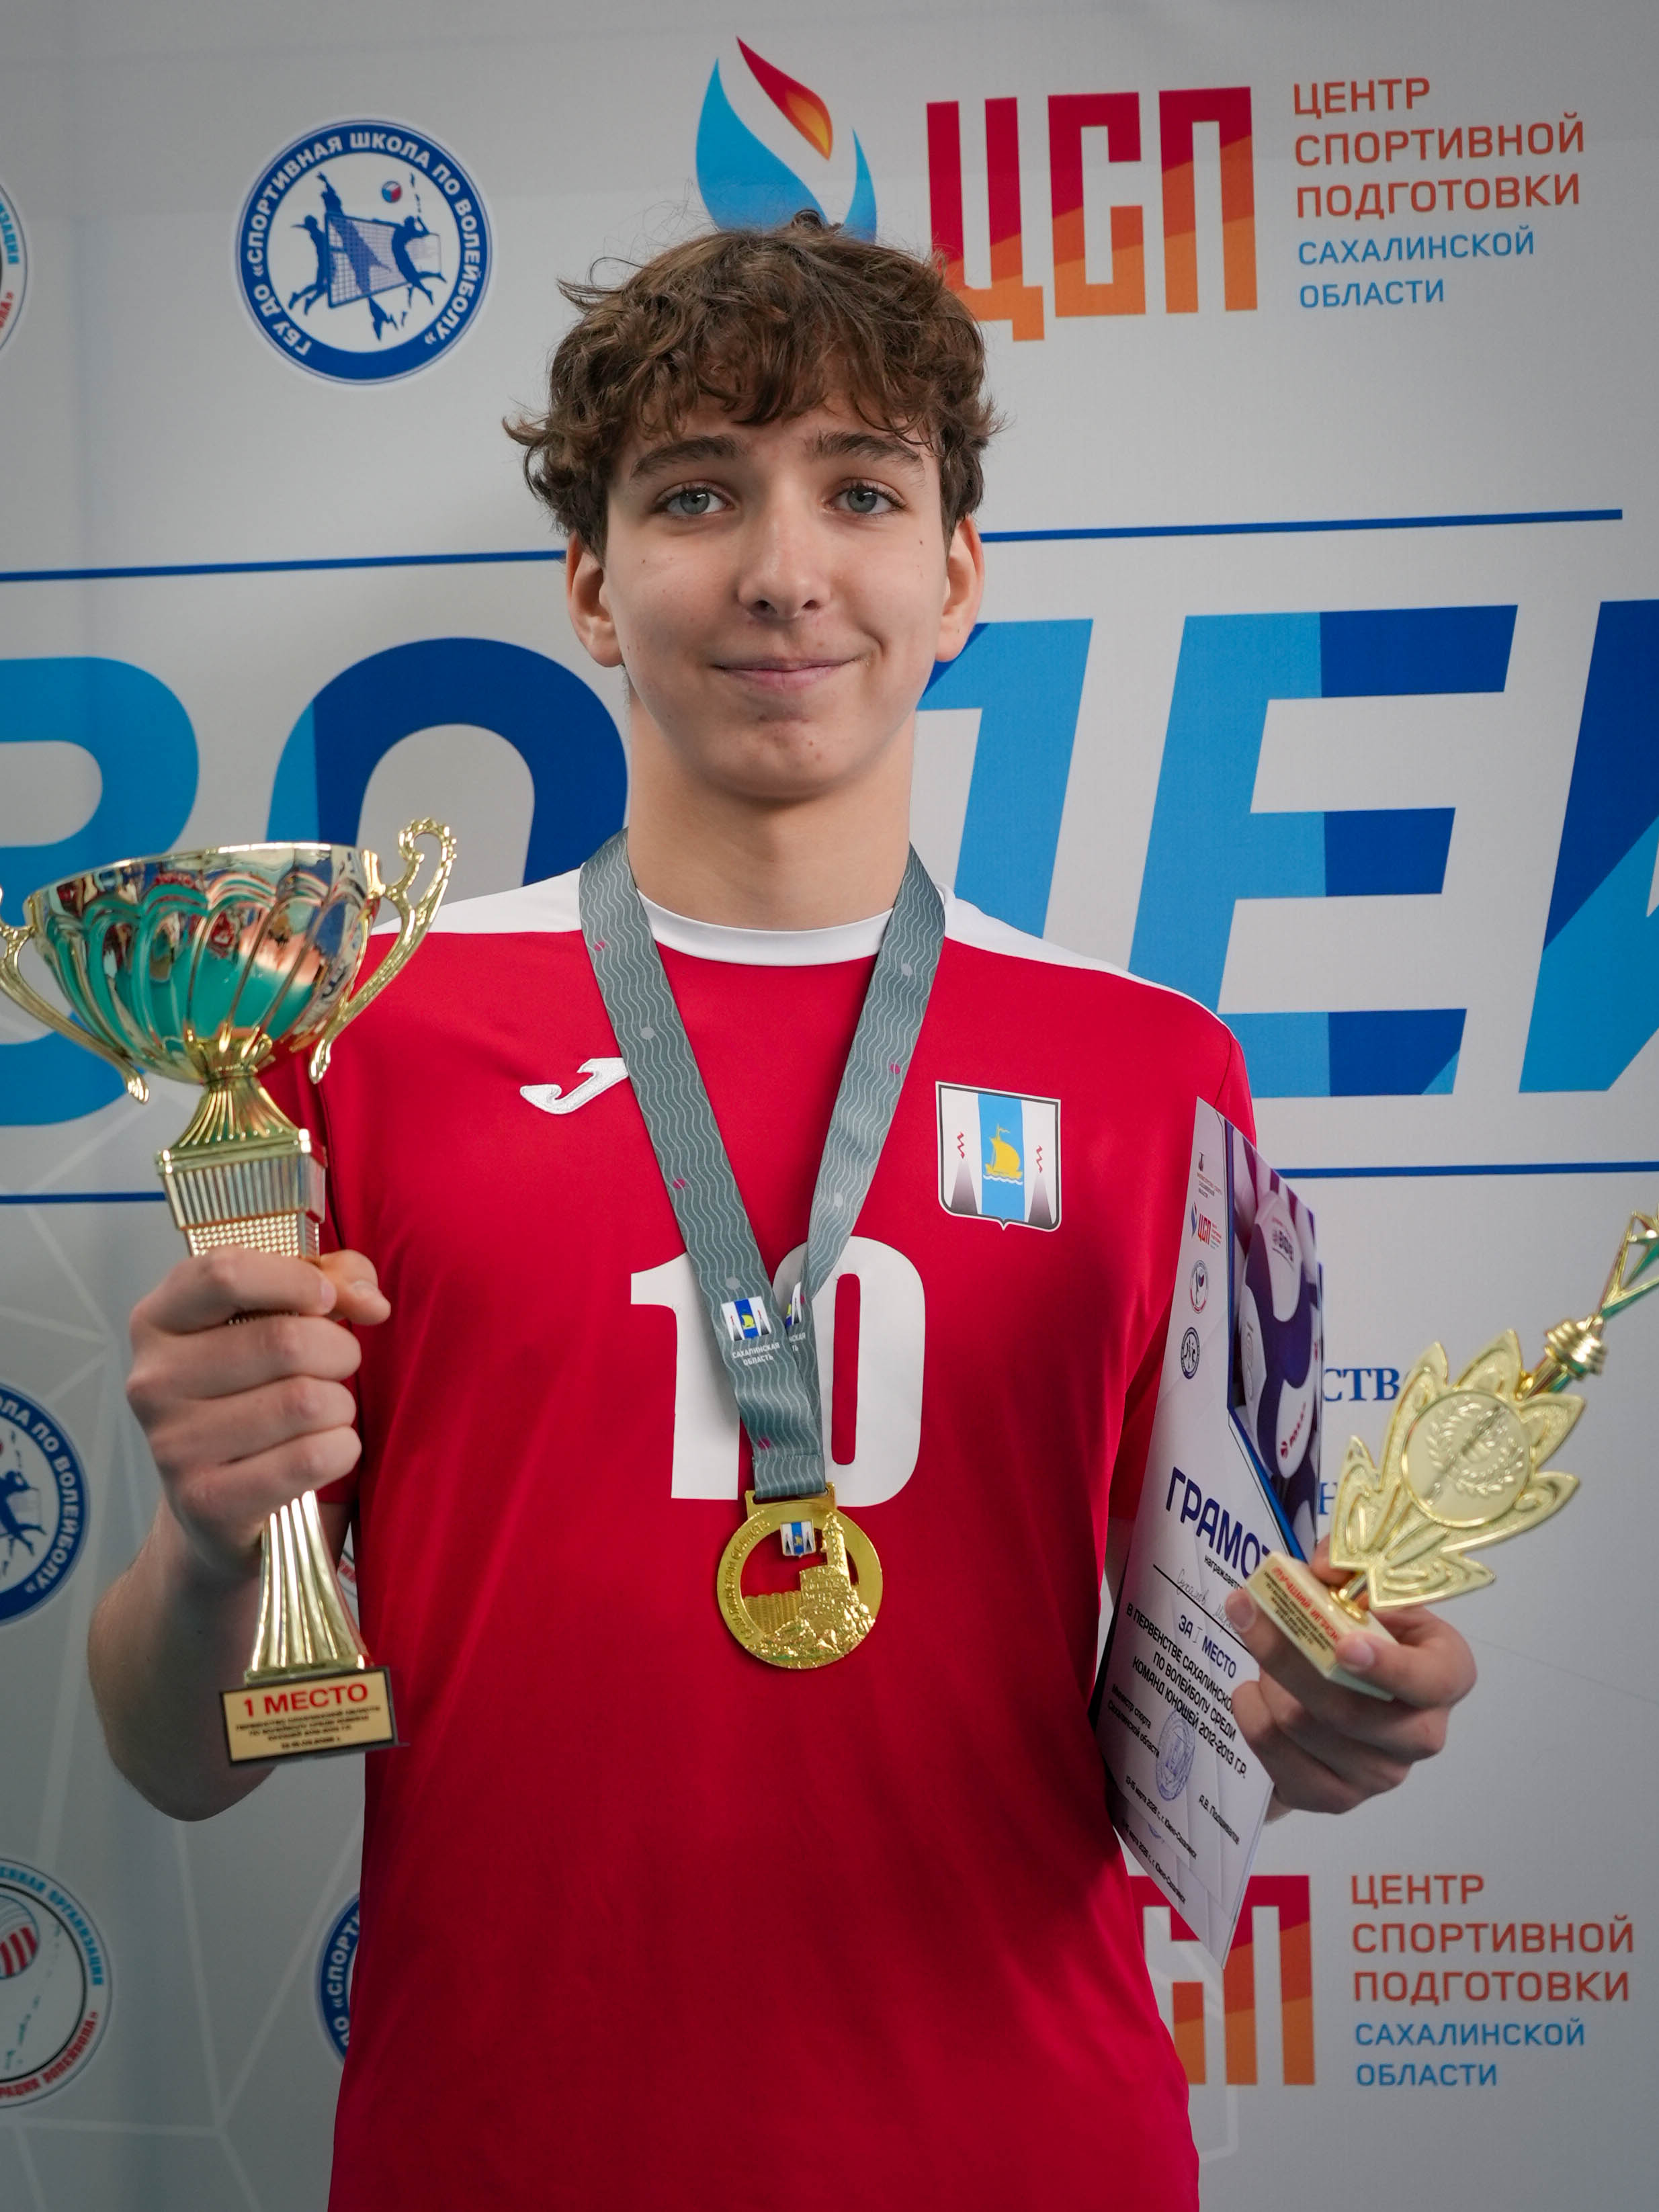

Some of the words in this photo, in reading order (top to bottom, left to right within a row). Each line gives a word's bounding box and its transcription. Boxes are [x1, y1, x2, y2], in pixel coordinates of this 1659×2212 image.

[1293, 77, 1430, 120] ЦЕНТР
[349, 132, 430, 169] ШКОЛА
[1294, 112, 1584, 167] СПОРТИВНОЙ
[432, 164, 461, 196] ПО
[1296, 173, 1580, 220] ПОДГОТОВКИ
[247, 135, 342, 277] «СПОРТИВНАЯ
[926, 85, 1258, 341] ЦСП
[1298, 224, 1534, 265] САХАЛИНСКОЙ
[425, 198, 482, 345] ВОЛЕЙБОЛУ»
[253, 285, 278, 317] ДО
[1300, 278, 1444, 308] ОБЛАСТИ
[273, 320, 312, 355] ГБУ
[732, 1342, 781, 1359] САХАЛИНСКАЯ
[743, 1354, 775, 1366] ОБЛАСТЬ
[630, 1236, 927, 1508] 10
[1323, 1367, 1400, 1402] СТВ
[32, 1422, 59, 1453] ПО
[1166, 1466, 1271, 1580] ГРАМО
[1127, 1603, 1134, 1617] В
[1134, 1612, 1183, 1663] ПЕРВЕНСТВЕ
[1182, 1654, 1234, 1715] САХАЛИНСКО
[1179, 1614, 1193, 1639] ЗА
[1201, 1635, 1237, 1678] МЕСТО
[244, 1697, 254, 1717] 1
[264, 1683, 368, 1715] МЕСТО
[1133, 1655, 1165, 1695] КОМАНД
[1164, 1687, 1199, 1730] ЮНОШЕЙ
[1198, 1721, 1235, 1765] 2012-2013
[1153, 1651, 1164, 1670] ПО
[1165, 1662, 1211, 1713] ВОЛЕЙБОЛУ
[1210, 1707, 1236, 1742] СРЕДИ
[1351, 1875, 1484, 1909] ЦЕНТР
[1352, 1915, 1634, 1954] СПОРТИВНОЙ
[1354, 1971, 1630, 2006] ПОДГОТОВКИ
[1355, 2016, 1586, 2047] САХАЛИНСКОЙ
[1356, 2062, 1498, 2086] ОБЛАСТИ
